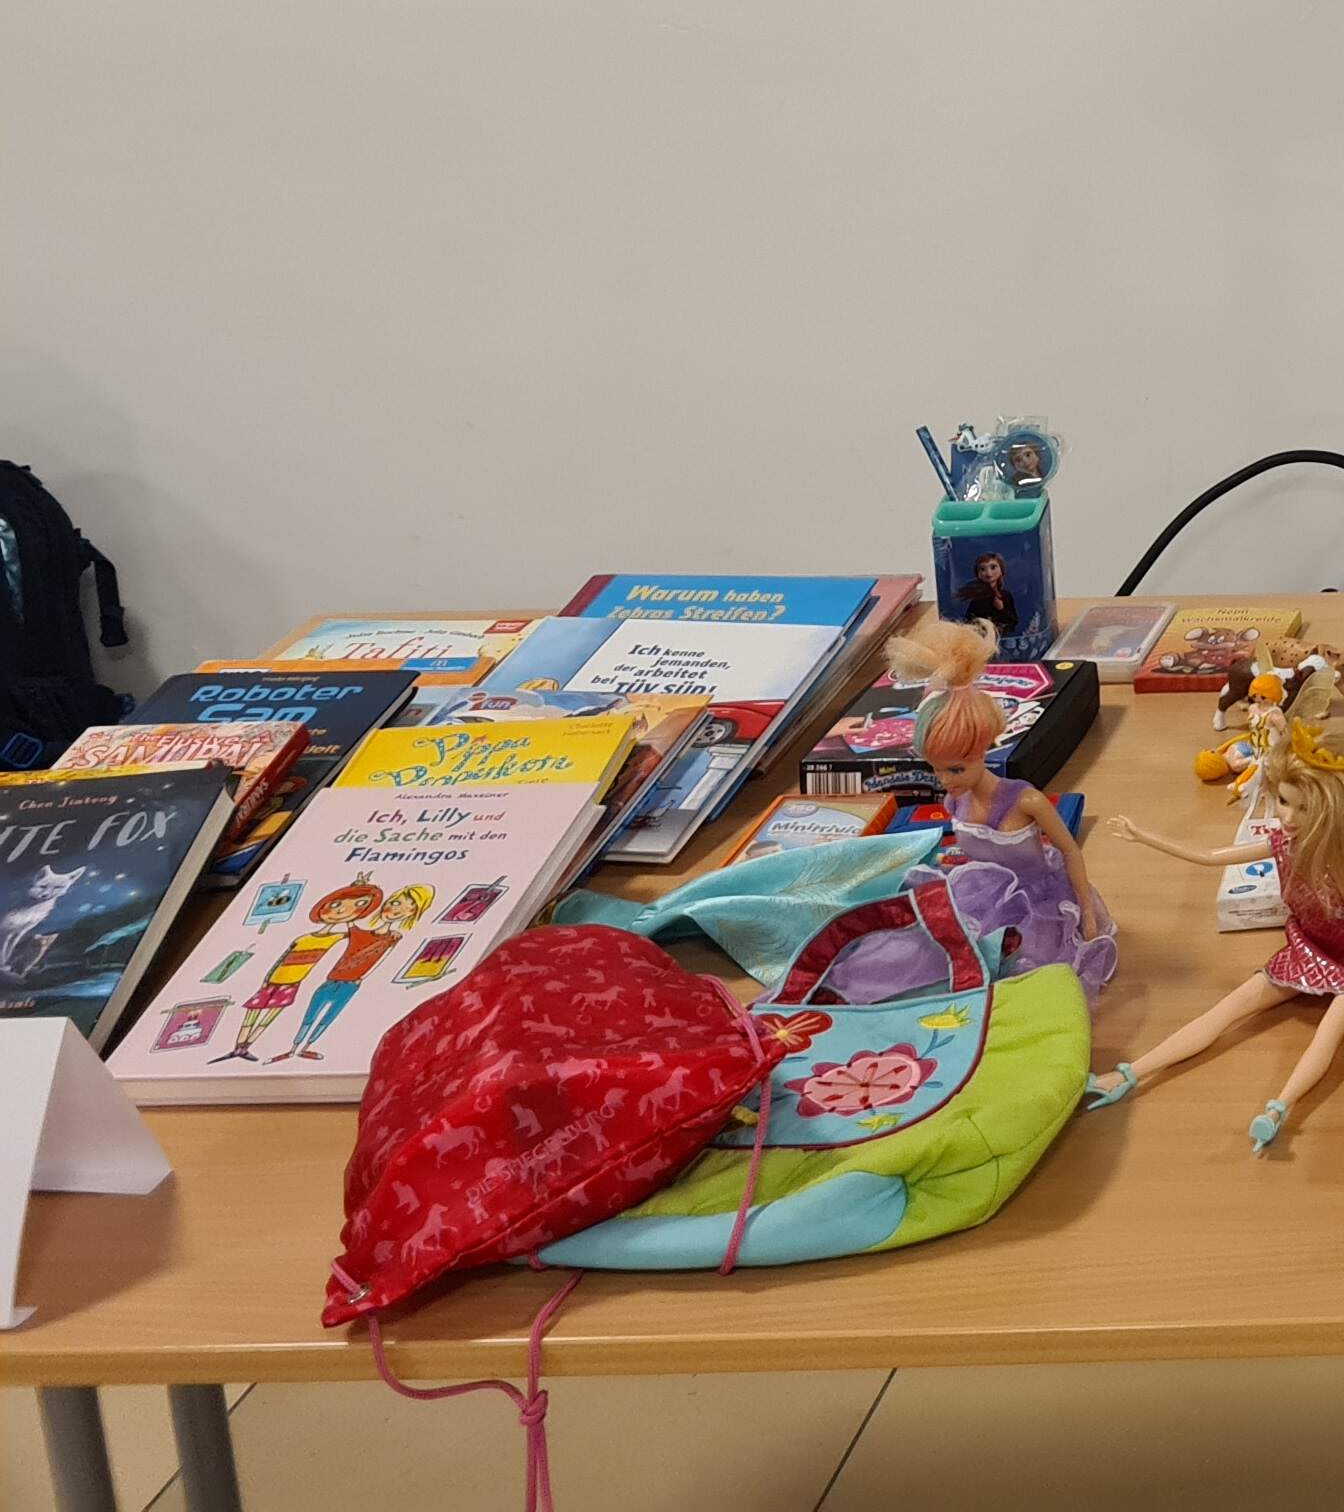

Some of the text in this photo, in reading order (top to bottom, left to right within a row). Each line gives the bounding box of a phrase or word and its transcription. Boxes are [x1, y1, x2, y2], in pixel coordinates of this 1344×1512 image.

[626, 585, 784, 603] Warum haben
[607, 605, 786, 622] Zebras Streifen?
[342, 636, 453, 659] Tafiti
[628, 644, 705, 658] Ich kenne
[613, 663, 708, 679] der arbeitet
[651, 657, 732, 669] jemanden,
[190, 684, 364, 702] Roboter
[590, 675, 616, 685] bei
[614, 679, 660, 693] TÜV
[79, 743, 262, 768] SAMURAI
[18, 798, 53, 810] Chen
[367, 807, 506, 828] Ich, Lilly und
[87, 811, 177, 851] FOX
[333, 827, 508, 844] die Sache mit den
[344, 847, 470, 866] Flamingos
